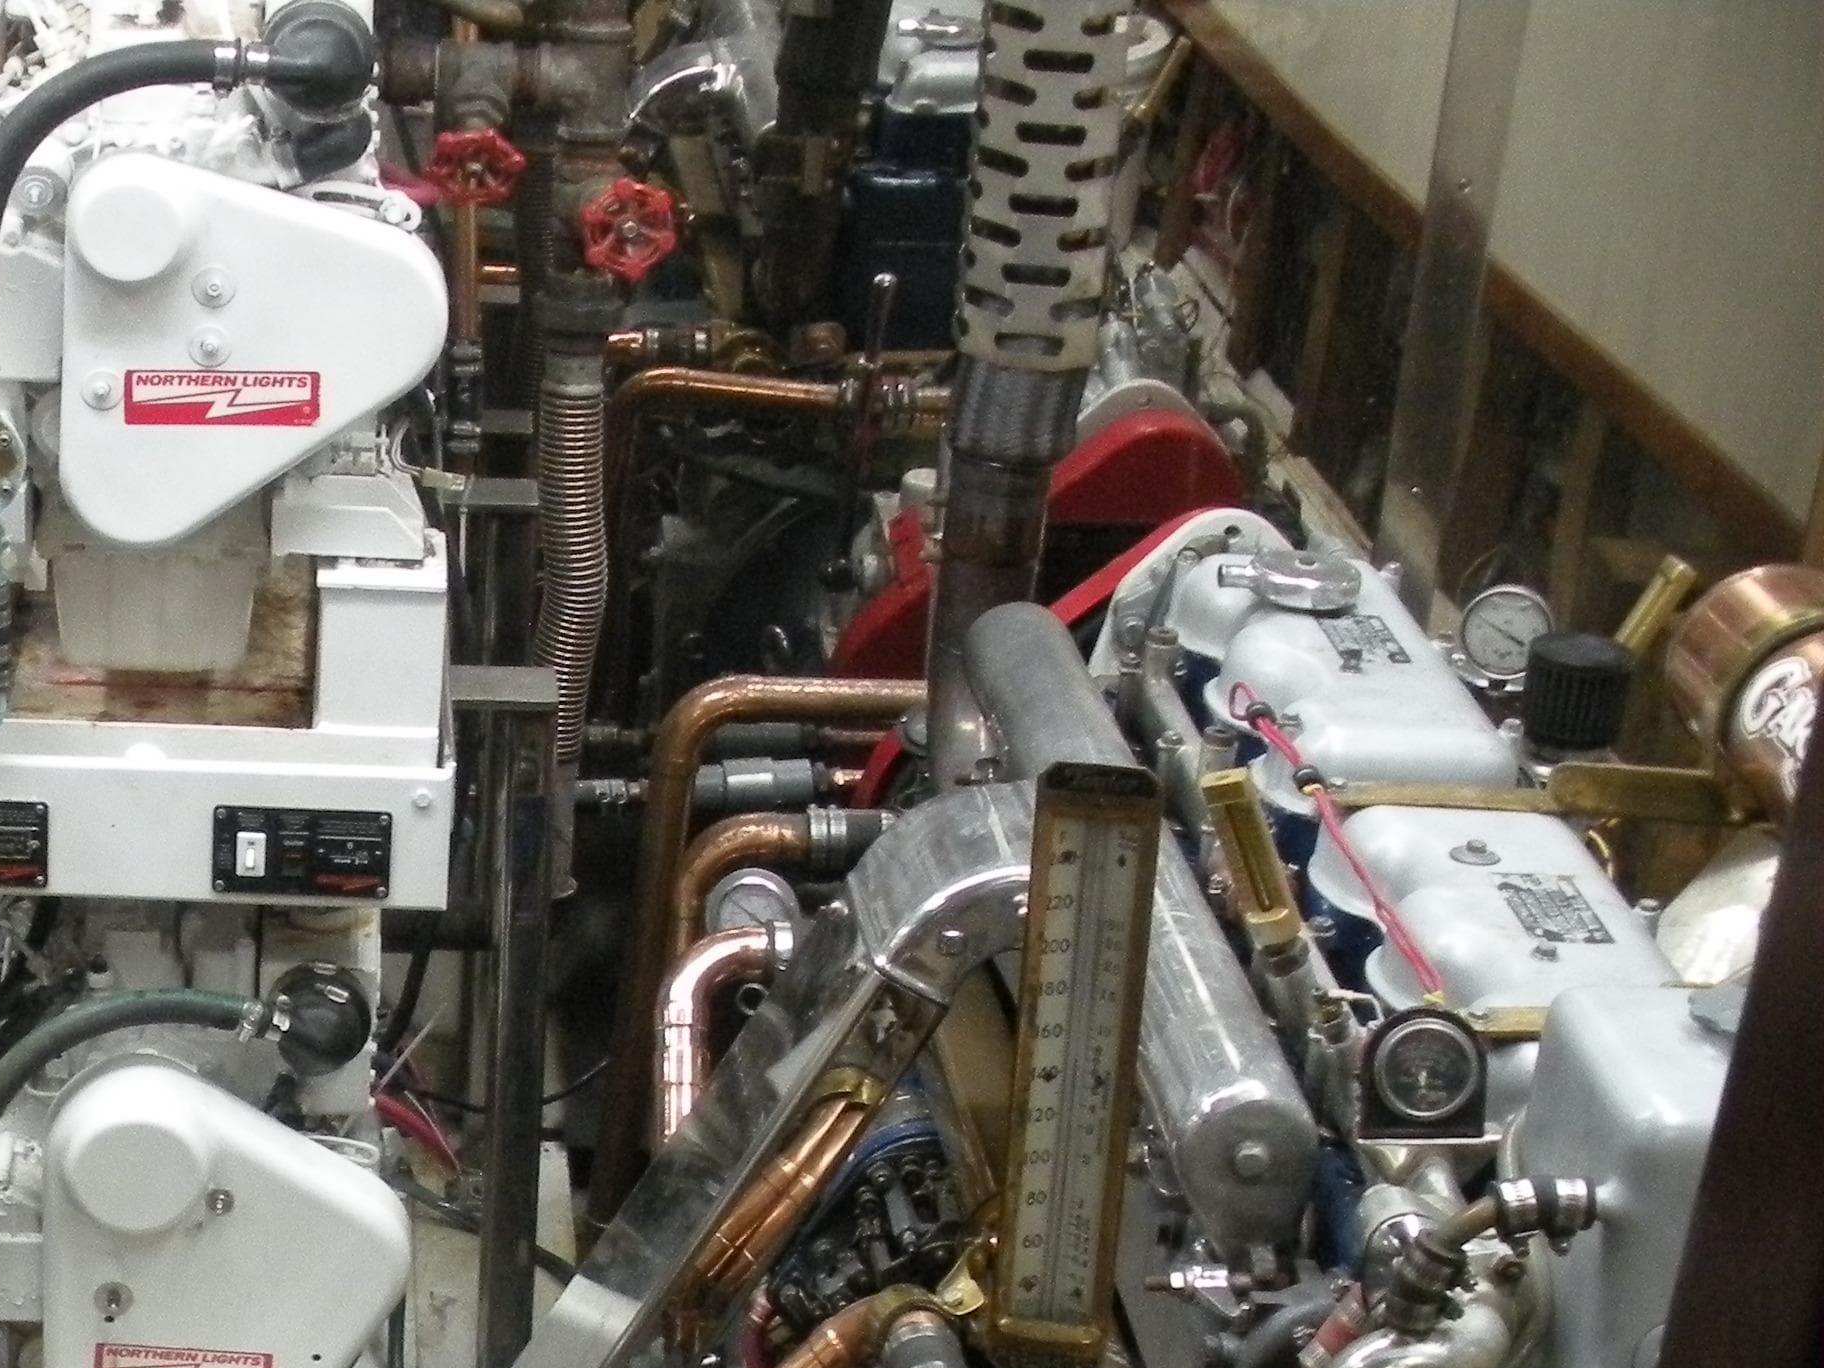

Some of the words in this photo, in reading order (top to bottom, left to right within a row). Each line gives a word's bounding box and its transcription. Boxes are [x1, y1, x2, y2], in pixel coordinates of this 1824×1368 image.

[135, 374, 237, 387] NORTHERN
[241, 375, 308, 388] LIGHTS
[1023, 1233, 1044, 1249] 60
[105, 1348, 197, 1362] NORTHERN
[202, 1353, 261, 1366] LIGHTS
